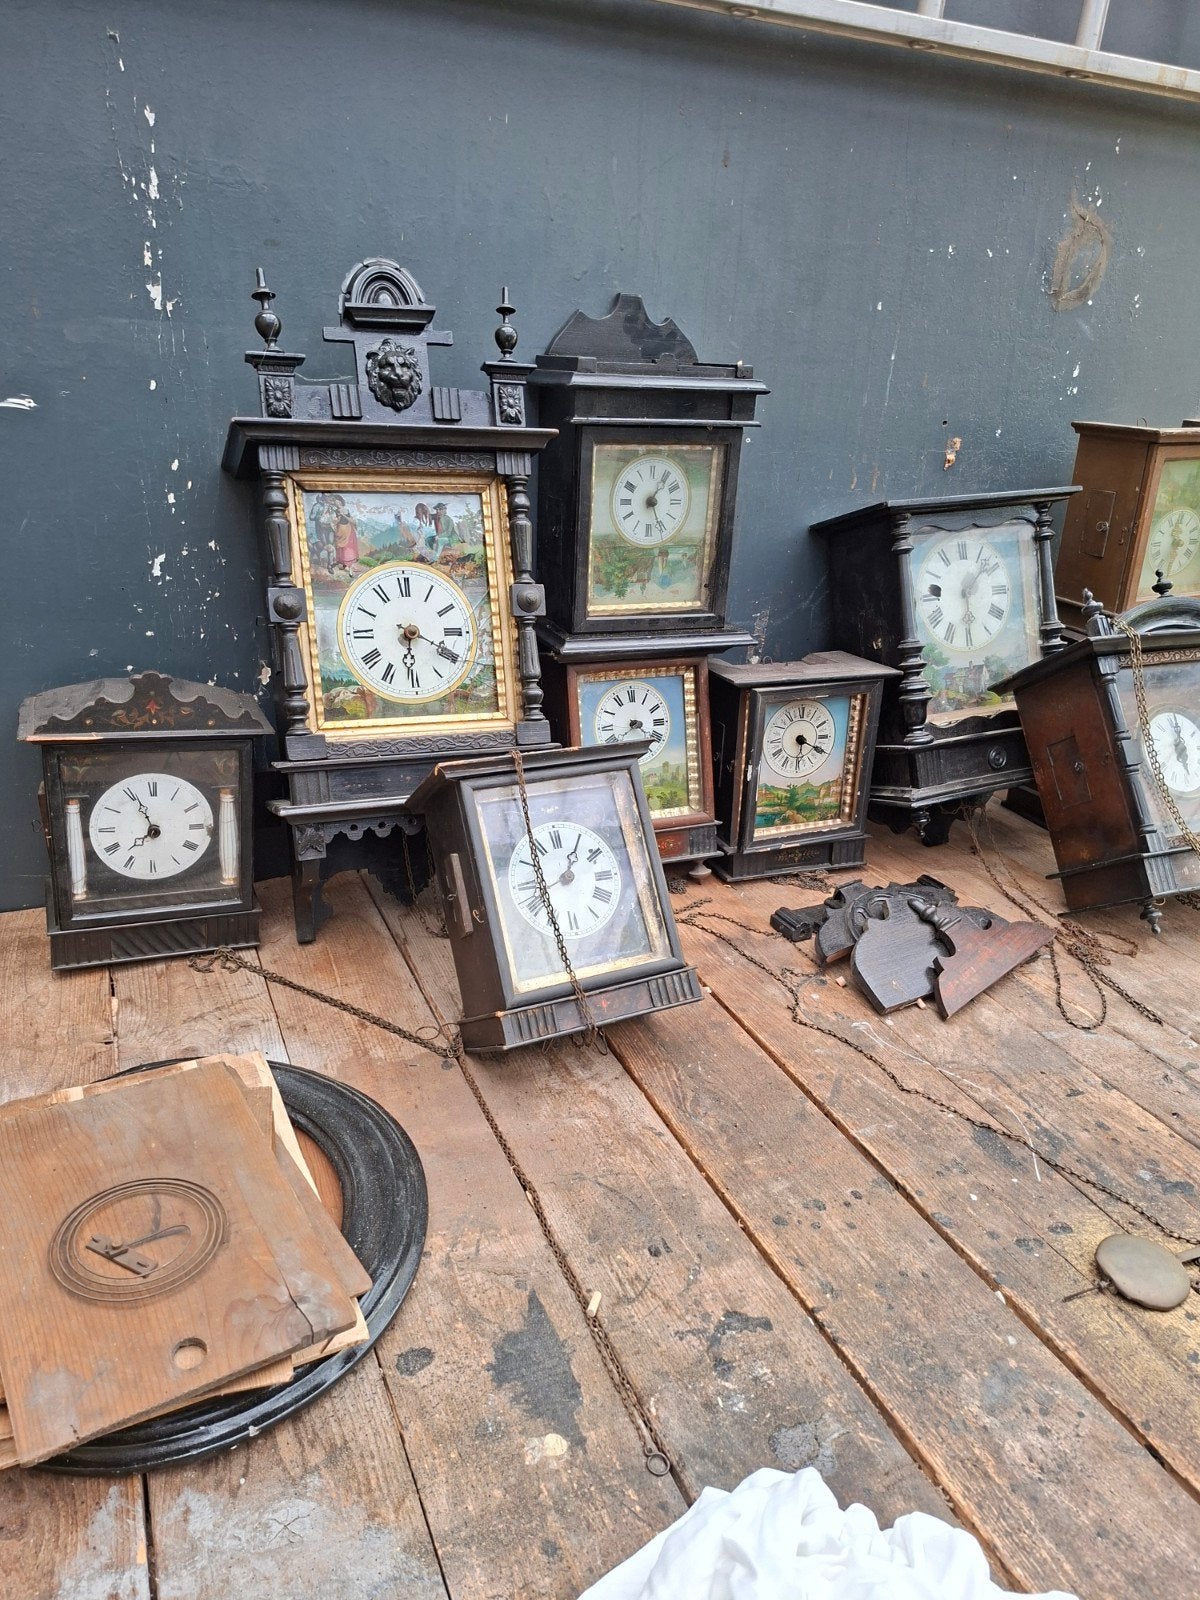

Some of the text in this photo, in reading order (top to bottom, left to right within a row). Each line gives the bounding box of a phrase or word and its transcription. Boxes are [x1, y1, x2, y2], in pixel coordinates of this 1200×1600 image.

[372, 584, 391, 605] XI
[396, 576, 412, 598] XII
[436, 602, 456, 618] II
[352, 627, 374, 640] IX
[443, 627, 463, 638] III
[360, 648, 383, 670] VIII
[380, 662, 397, 686] VII
[612, 694, 624, 708] XI
[626, 689, 636, 704] XII
[146, 781, 158, 798] XII
[548, 830, 562, 850] XII
